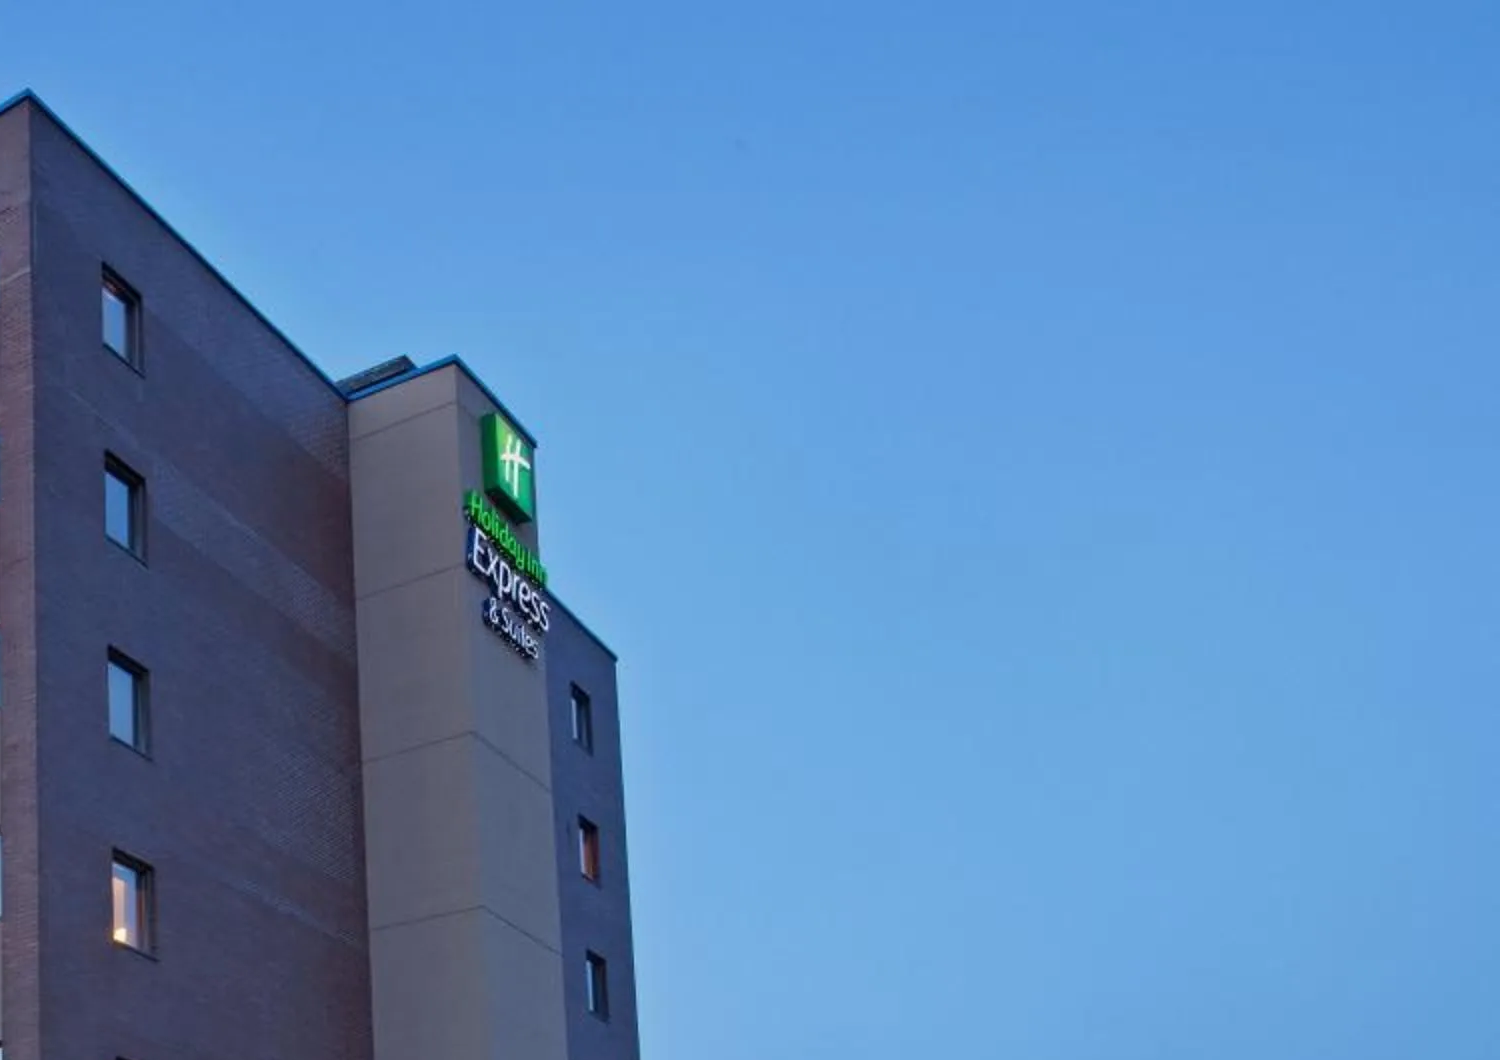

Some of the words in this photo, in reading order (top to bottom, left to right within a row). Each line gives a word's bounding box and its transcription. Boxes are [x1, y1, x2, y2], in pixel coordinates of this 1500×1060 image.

[468, 490, 526, 570] Holiday
[526, 549, 548, 586] Inn
[472, 527, 550, 633] Express
[489, 597, 500, 625] &
[501, 607, 540, 660] Suites
